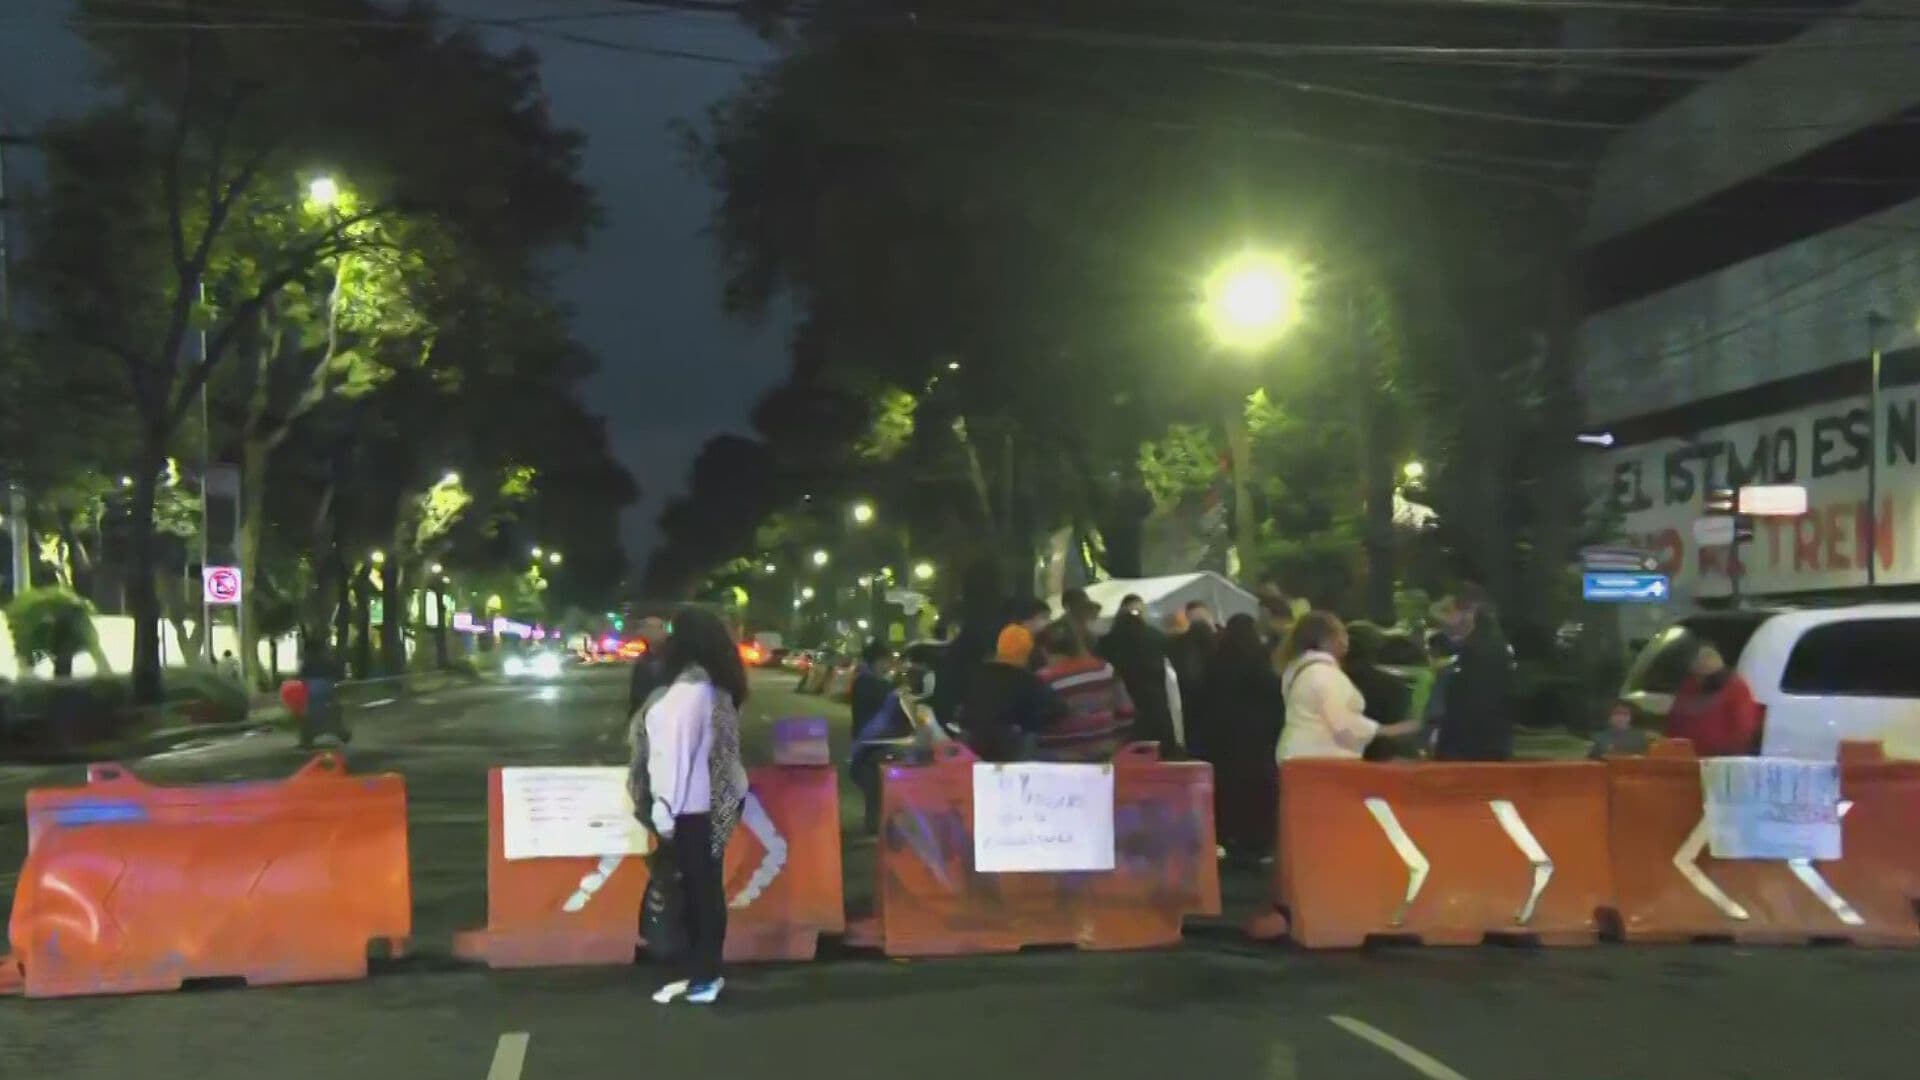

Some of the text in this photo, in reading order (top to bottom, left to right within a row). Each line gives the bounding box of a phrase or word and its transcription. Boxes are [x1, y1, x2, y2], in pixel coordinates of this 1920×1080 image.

[1612, 459, 1653, 513] EL
[1663, 427, 1799, 507] ISTMO
[1811, 408, 1872, 479] ES
[1757, 494, 1895, 572] TREN
